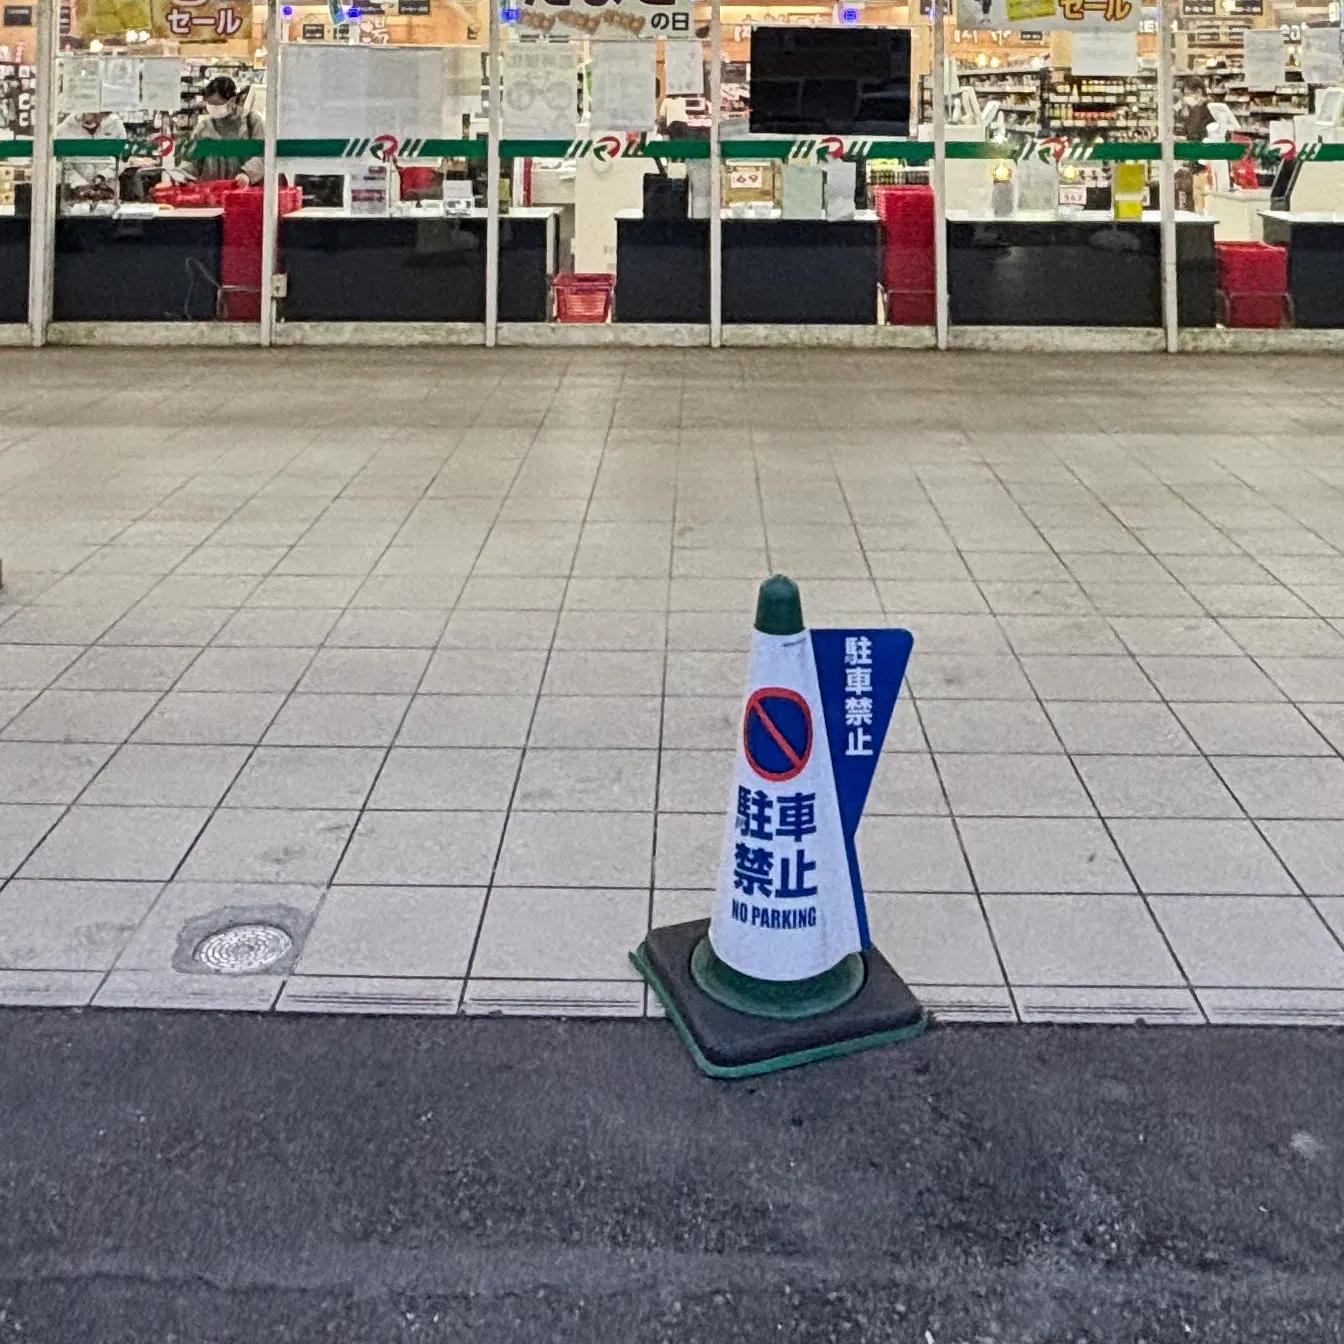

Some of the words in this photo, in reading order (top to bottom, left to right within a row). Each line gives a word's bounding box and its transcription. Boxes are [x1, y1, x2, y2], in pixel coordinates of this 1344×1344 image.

[167, 8, 242, 35] セール
[651, 12, 689, 31] の日
[845, 636, 874, 757] 駐車禁止
[736, 785, 816, 843] 駐車
[733, 843, 817, 899] 禁止
[732, 898, 748, 923] NO
[751, 905, 817, 930] PARKING
